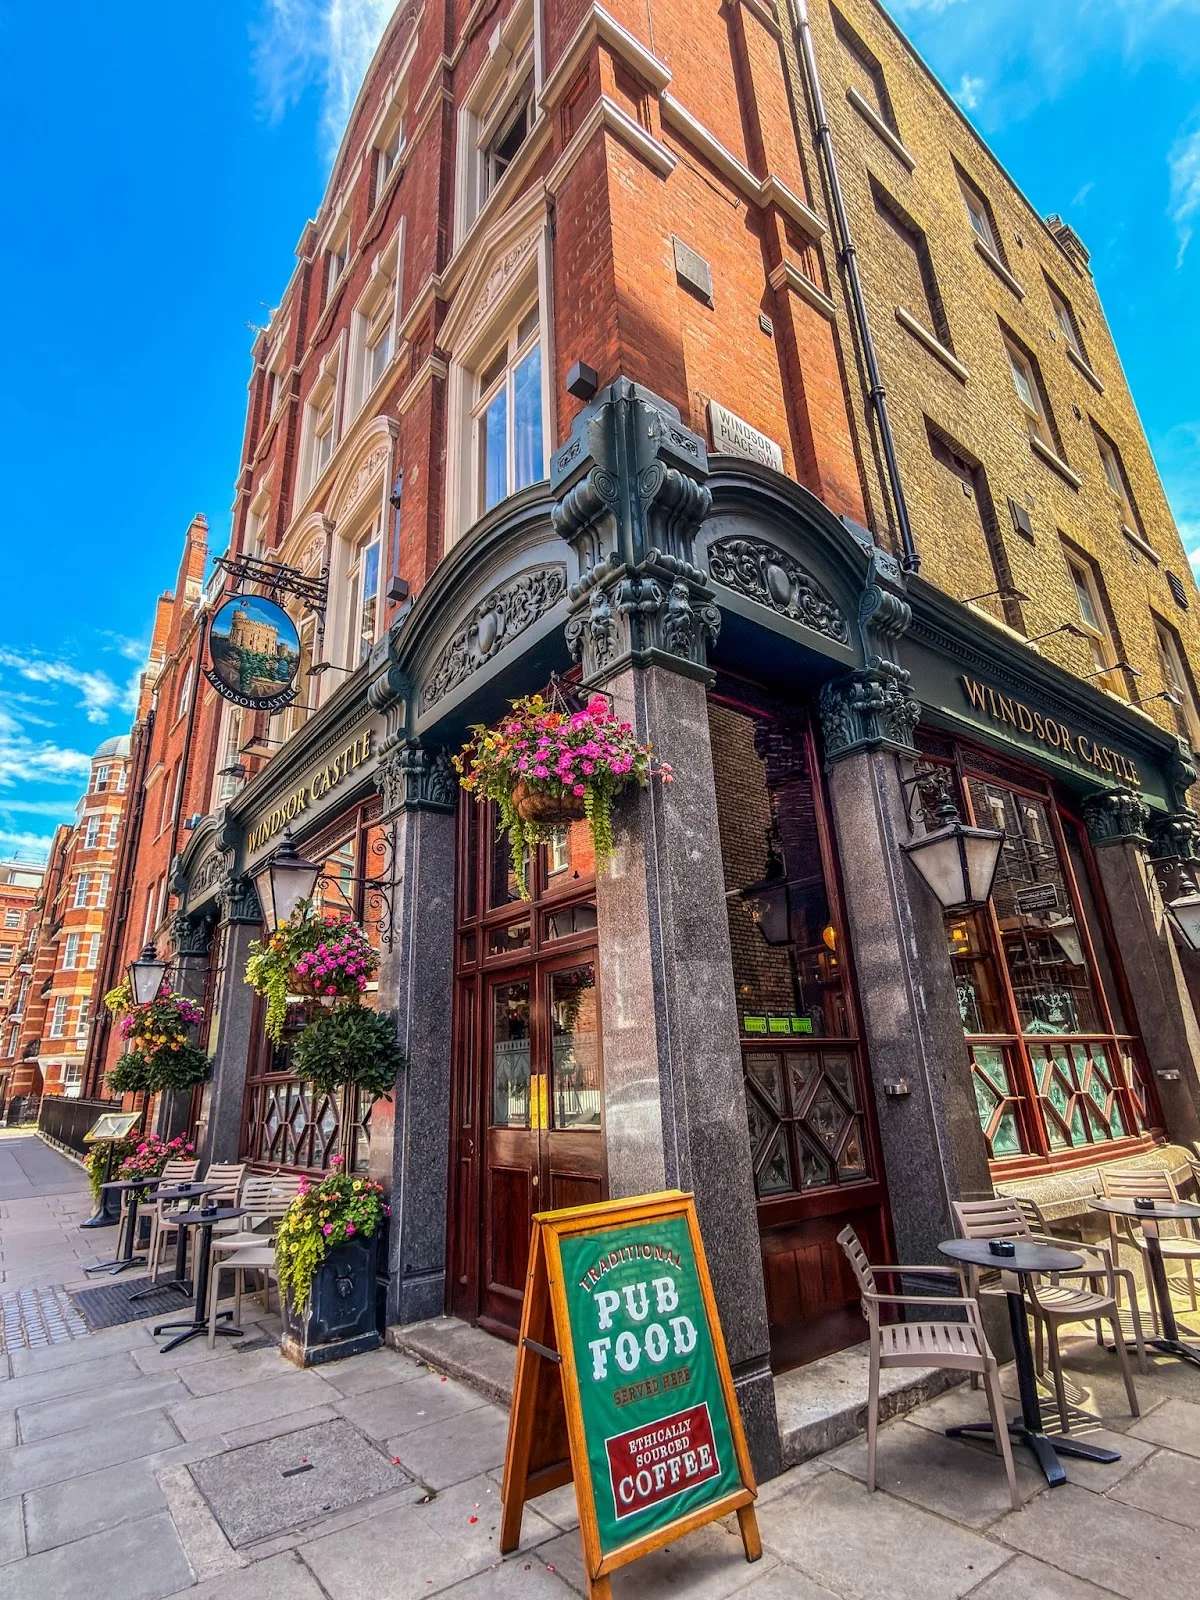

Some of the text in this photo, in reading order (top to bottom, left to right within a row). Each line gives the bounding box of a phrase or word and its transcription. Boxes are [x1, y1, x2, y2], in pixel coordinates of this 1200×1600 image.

[719, 409, 772, 455] WINDSOR
[720, 425, 778, 471] PLACE SW1
[207, 671, 296, 708] WINDSOR CASTLE
[961, 674, 1141, 786] WINDSOR CASTLE
[247, 728, 373, 854] WINDSOR CASTLE
[579, 1243, 682, 1292] TRADITIONAL
[594, 1276, 679, 1330] PUB
[588, 1316, 698, 1380] FOOD
[613, 1368, 691, 1406] SERVED HERE
[628, 1419, 692, 1454] ETHICALLY
[636, 1436, 690, 1468] SOURCED
[619, 1443, 713, 1503] COFFEE
